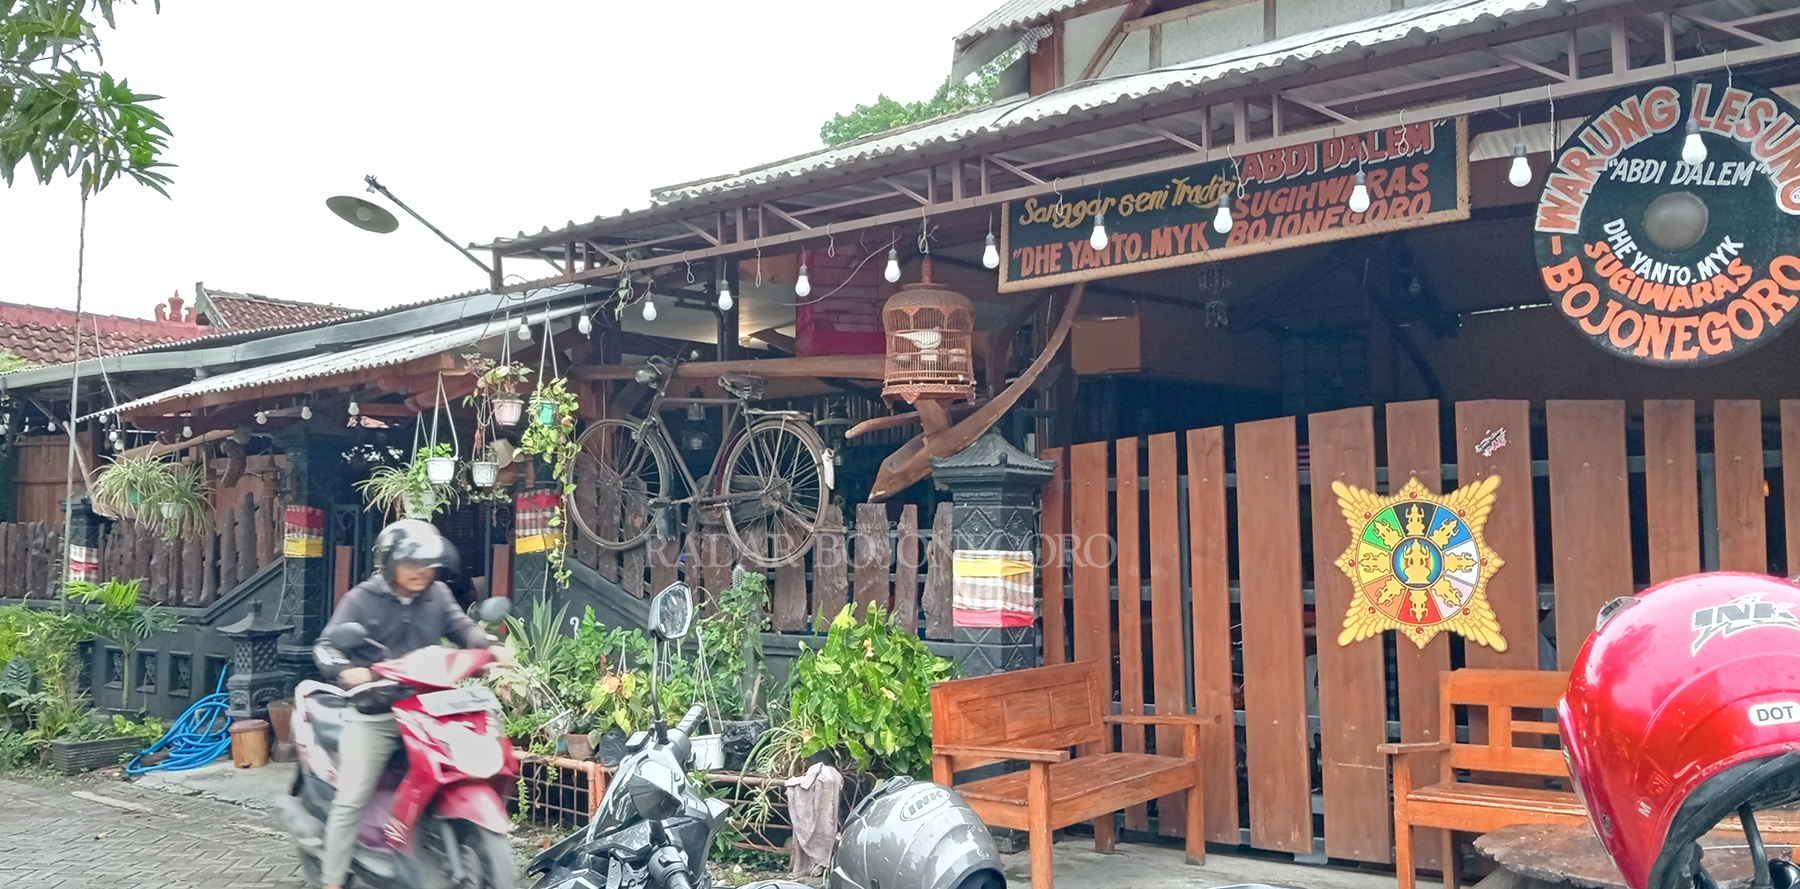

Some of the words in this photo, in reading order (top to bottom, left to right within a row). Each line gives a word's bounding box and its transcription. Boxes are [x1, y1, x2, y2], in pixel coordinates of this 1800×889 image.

[1535, 86, 1680, 234] WARUNG
[1019, 196, 1116, 229] Sanggar
[1603, 217, 1638, 260] DHE
[1584, 240, 1753, 312] SUGIWARAS
[1541, 254, 1800, 360] BOJONEGORO
[1756, 706, 1794, 722] DOT
[908, 791, 944, 815] INK
